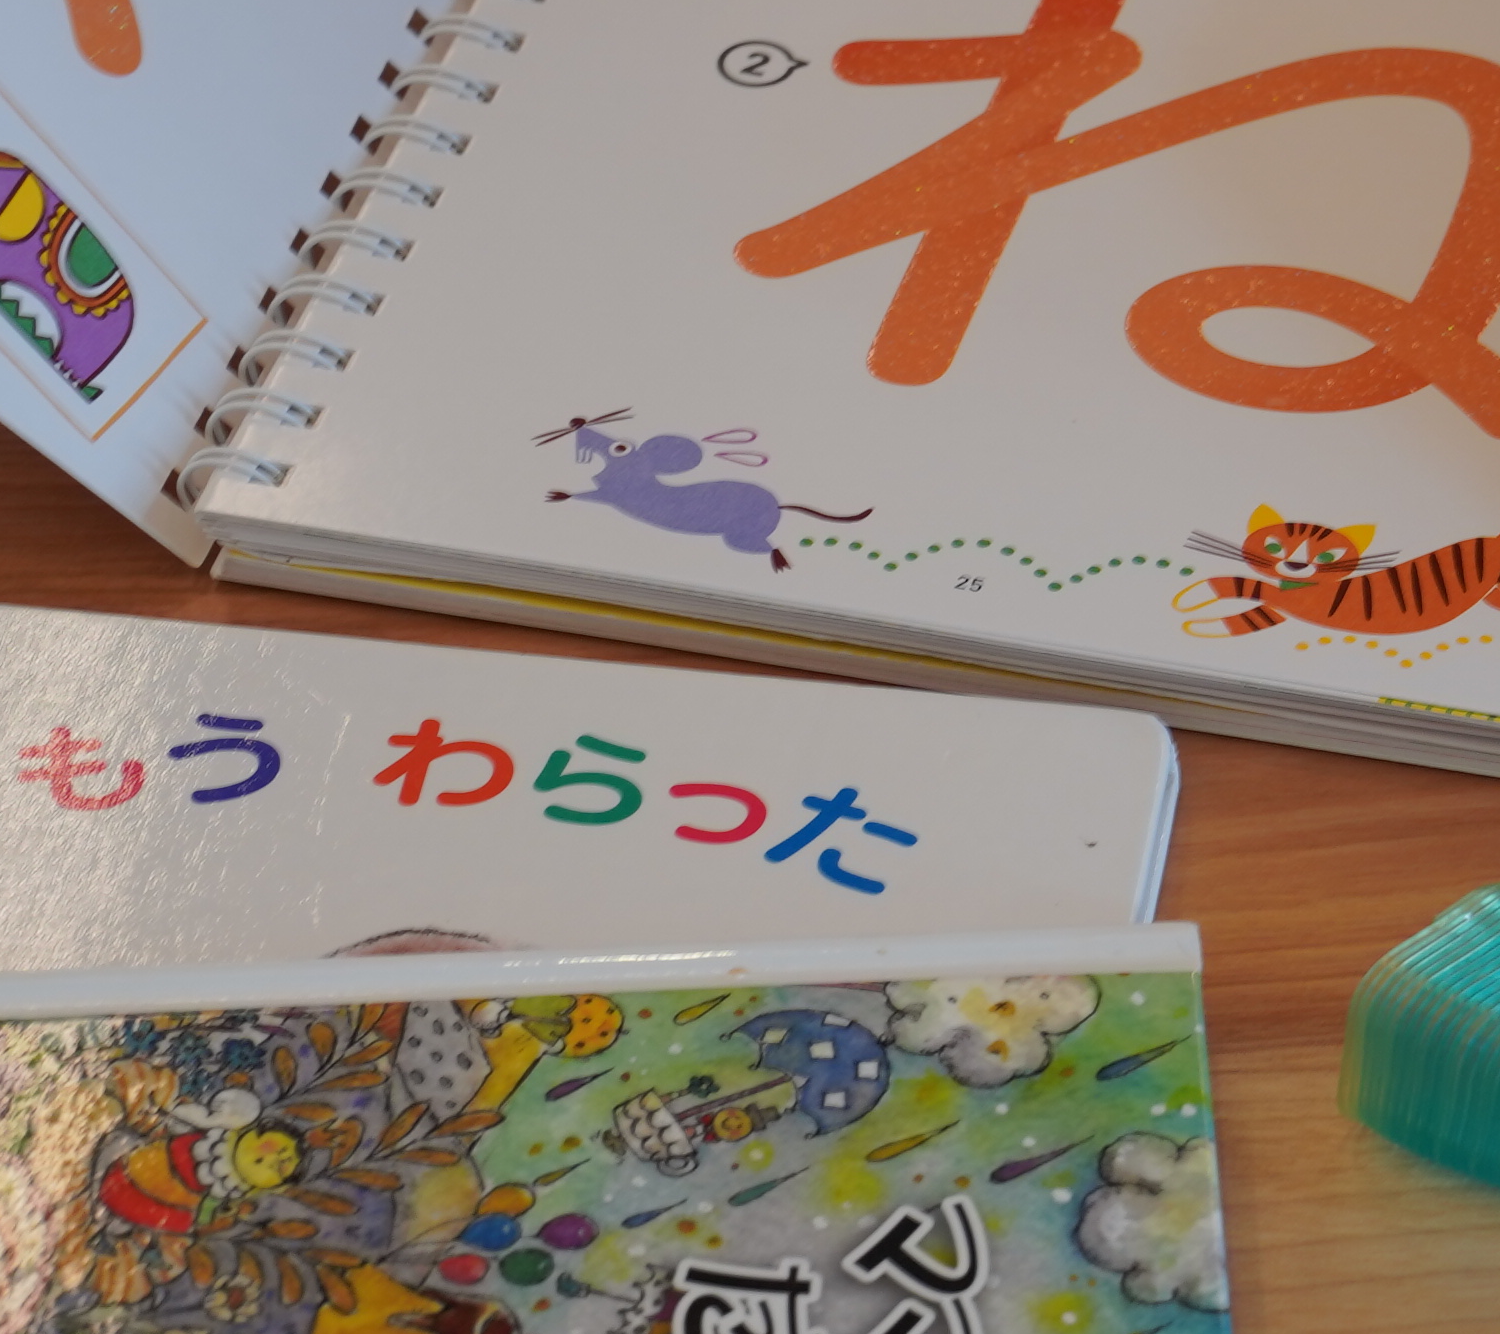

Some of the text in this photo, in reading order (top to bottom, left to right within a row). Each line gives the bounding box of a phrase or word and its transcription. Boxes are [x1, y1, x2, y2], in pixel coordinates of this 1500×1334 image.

[953, 573, 985, 593] 25
[16, 712, 918, 896] もう わらった
